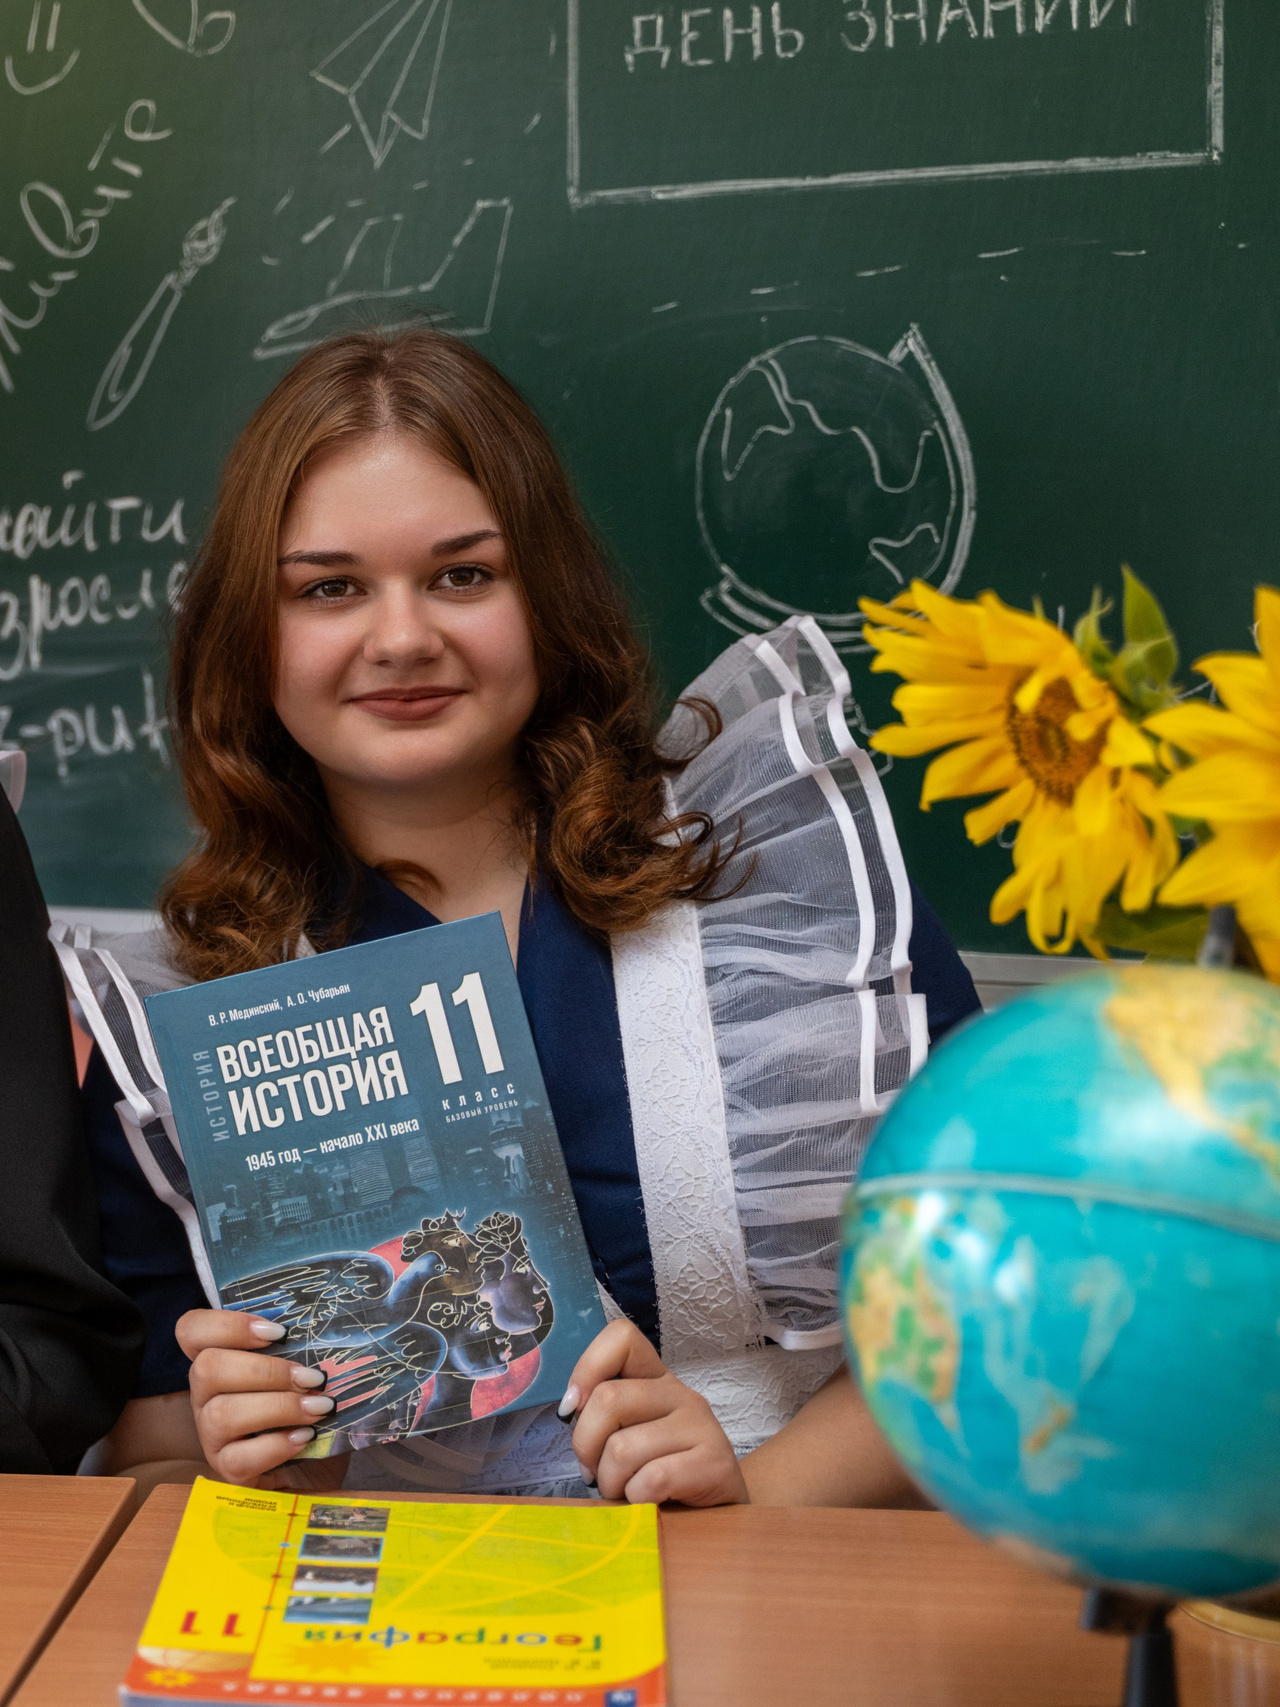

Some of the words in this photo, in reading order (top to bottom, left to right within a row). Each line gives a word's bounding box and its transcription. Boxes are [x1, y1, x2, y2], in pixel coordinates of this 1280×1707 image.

[625, 2, 805, 73] ДЕНЬ
[208, 1014, 219, 1027] В.
[219, 1012, 229, 1024] Р.
[228, 998, 284, 1022] Мединский,
[286, 995, 297, 1008] А.
[297, 992, 308, 1005] О.
[308, 983, 351, 1003] Чубарьян
[409, 971, 505, 1085] 11
[216, 1006, 395, 1084] ВСЕОБЩАЯ
[192, 1049, 230, 1142] ИСТОРИЯ
[228, 1049, 410, 1136] ИСТОРИЯ
[445, 1108, 482, 1123] БАЗОВЫЙ
[484, 1099, 519, 1114] УРОВЕНЬ
[245, 1150, 276, 1172] 1945
[278, 1148, 302, 1165] год
[320, 1132, 363, 1154] начало
[364, 1122, 388, 1142] XXI
[391, 1118, 420, 1137] века
[180, 1610, 243, 1638] 11
[303, 1625, 603, 1653] География
